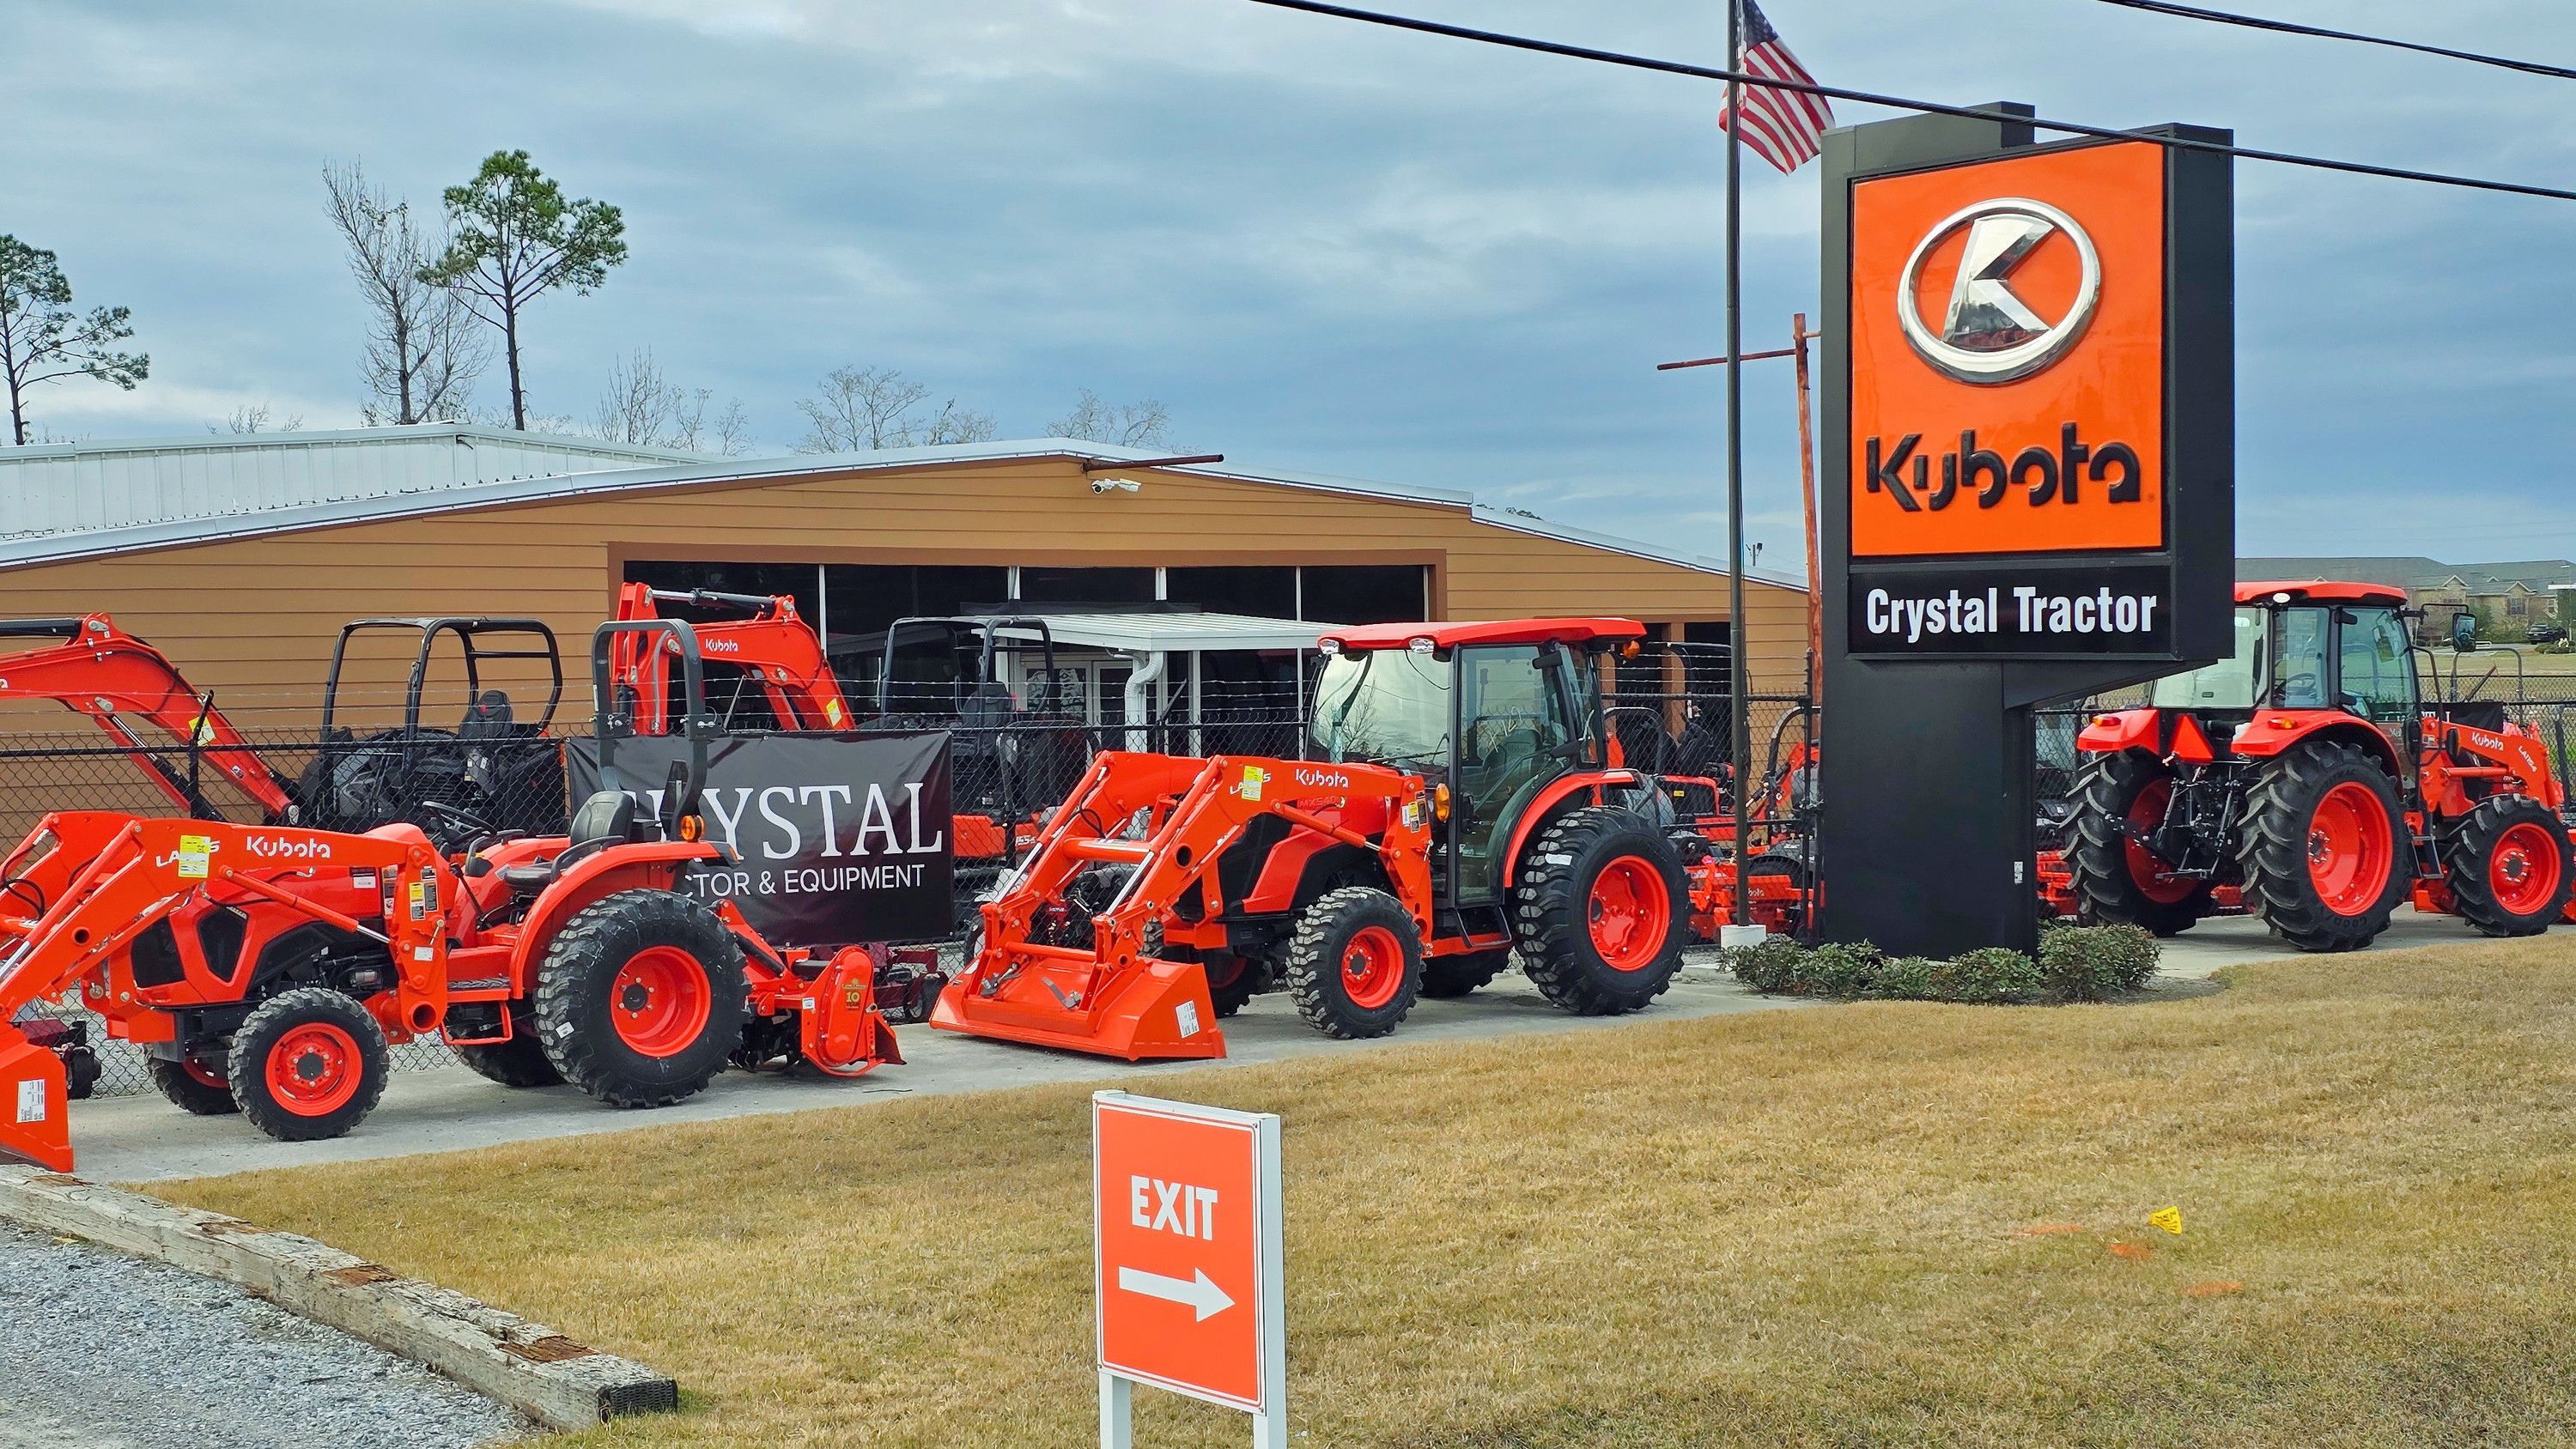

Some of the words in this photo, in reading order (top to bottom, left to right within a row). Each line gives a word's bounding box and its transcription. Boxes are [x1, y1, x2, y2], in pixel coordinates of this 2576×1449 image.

[1865, 421, 2142, 512] Kubota
[1866, 587, 1998, 644] Crystal
[2013, 585, 2158, 634] Tractor
[705, 638, 738, 652] Kubota
[2470, 731, 2505, 752] Kubota
[1295, 768, 1349, 788] Kubota
[620, 782, 943, 861] YSTAL
[246, 835, 331, 858] Kubota
[759, 870, 776, 894] &
[784, 864, 926, 894] EQUIPMENT
[1131, 1174, 1218, 1241] EXIT
